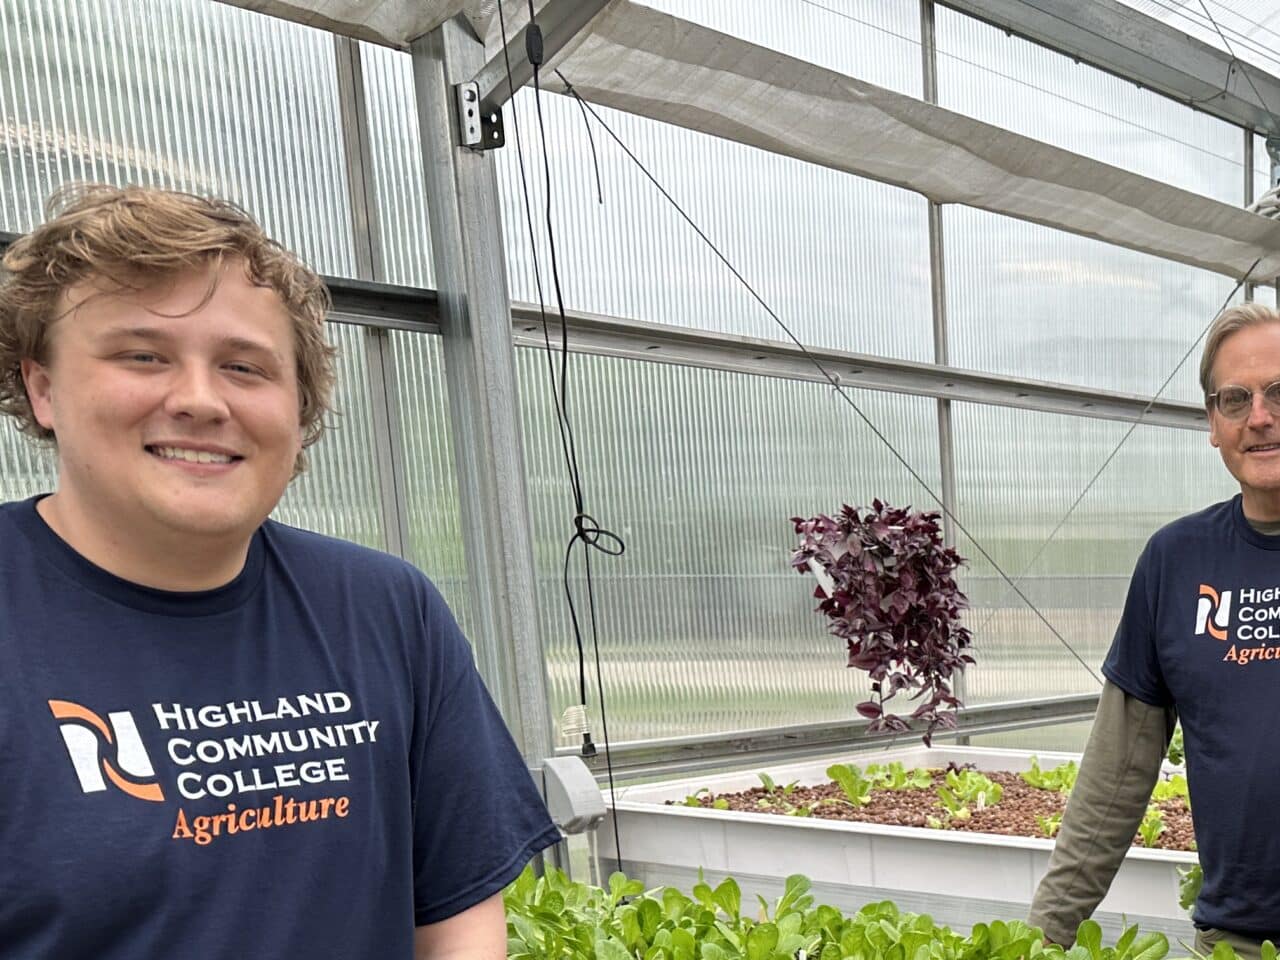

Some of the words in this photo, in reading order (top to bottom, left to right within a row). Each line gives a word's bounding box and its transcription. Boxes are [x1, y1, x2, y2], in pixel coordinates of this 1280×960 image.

[152, 691, 352, 731] HIGHLAND
[167, 720, 380, 766] COMMUNITY
[176, 758, 350, 800] COLLEGE
[172, 793, 350, 845] Agriculture
